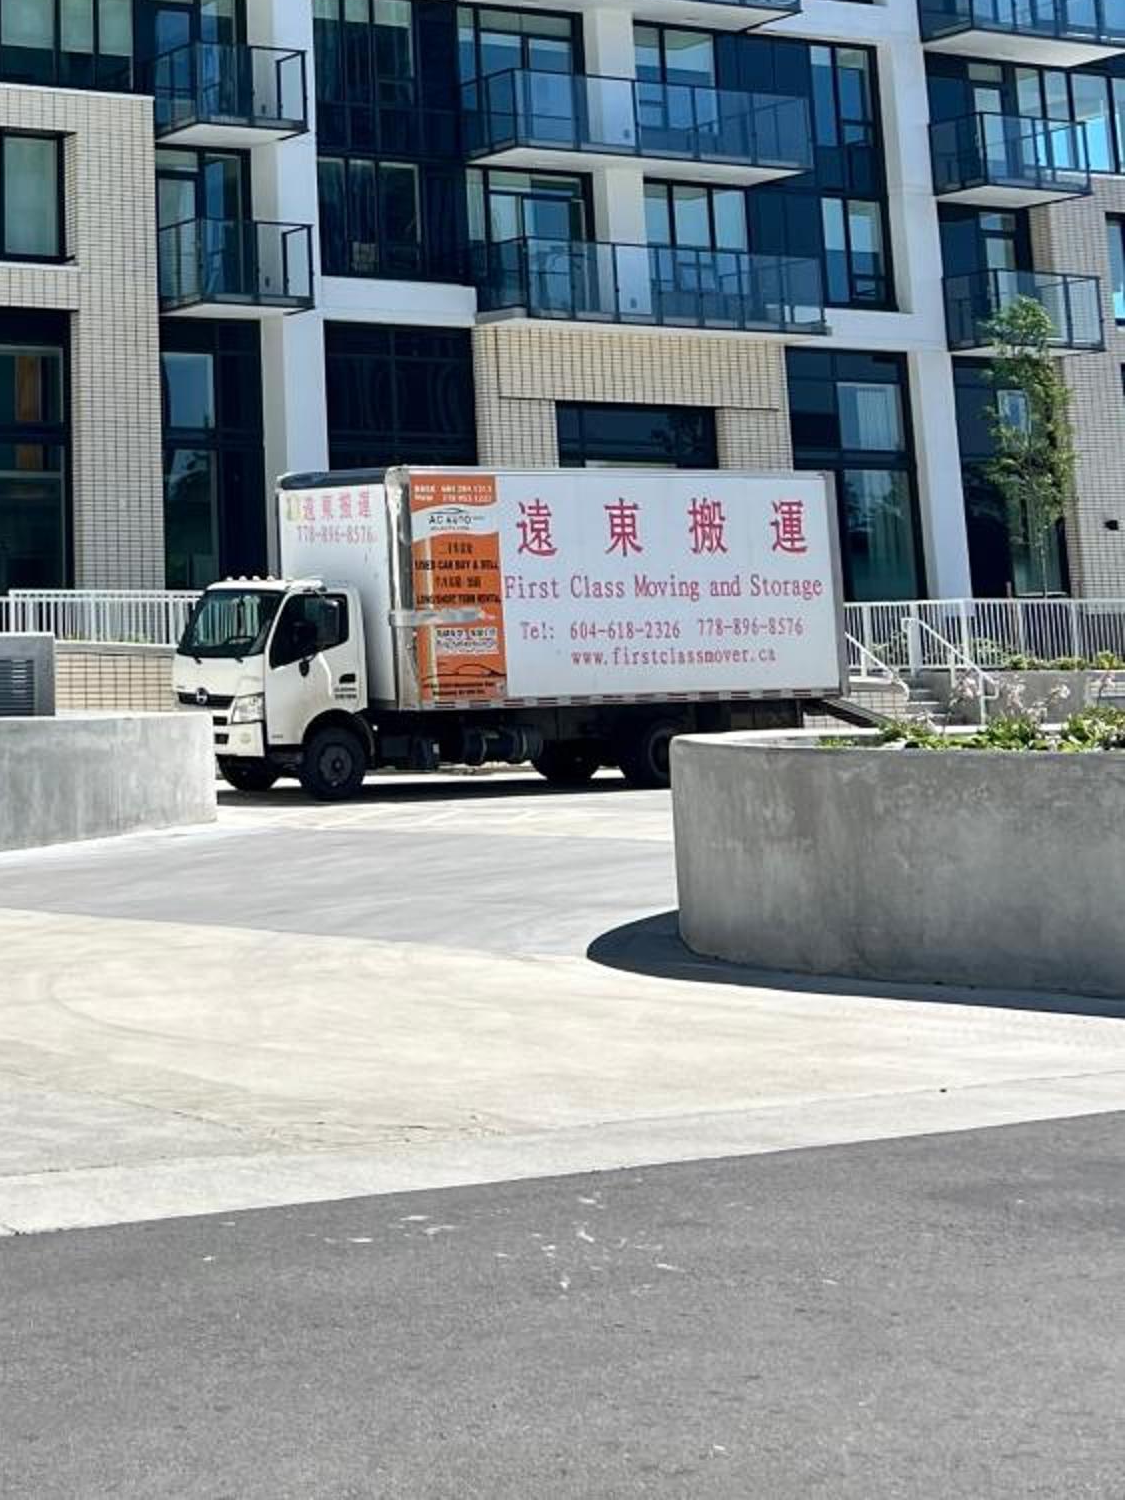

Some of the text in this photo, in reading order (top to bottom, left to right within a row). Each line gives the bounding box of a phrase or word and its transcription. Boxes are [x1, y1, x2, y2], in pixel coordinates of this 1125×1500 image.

[516, 497, 809, 557] 遠東搬運
[505, 576, 560, 599] First
[570, 575, 625, 599] Class
[634, 574, 700, 602] Moving
[710, 574, 741, 597] and
[750, 574, 822, 601] Storage
[520, 621, 555, 640] Tel:
[570, 619, 681, 640] 604-618-2326
[698, 617, 804, 637] 778-896-8576
[571, 647, 776, 666] www.firstclassmover.ca
